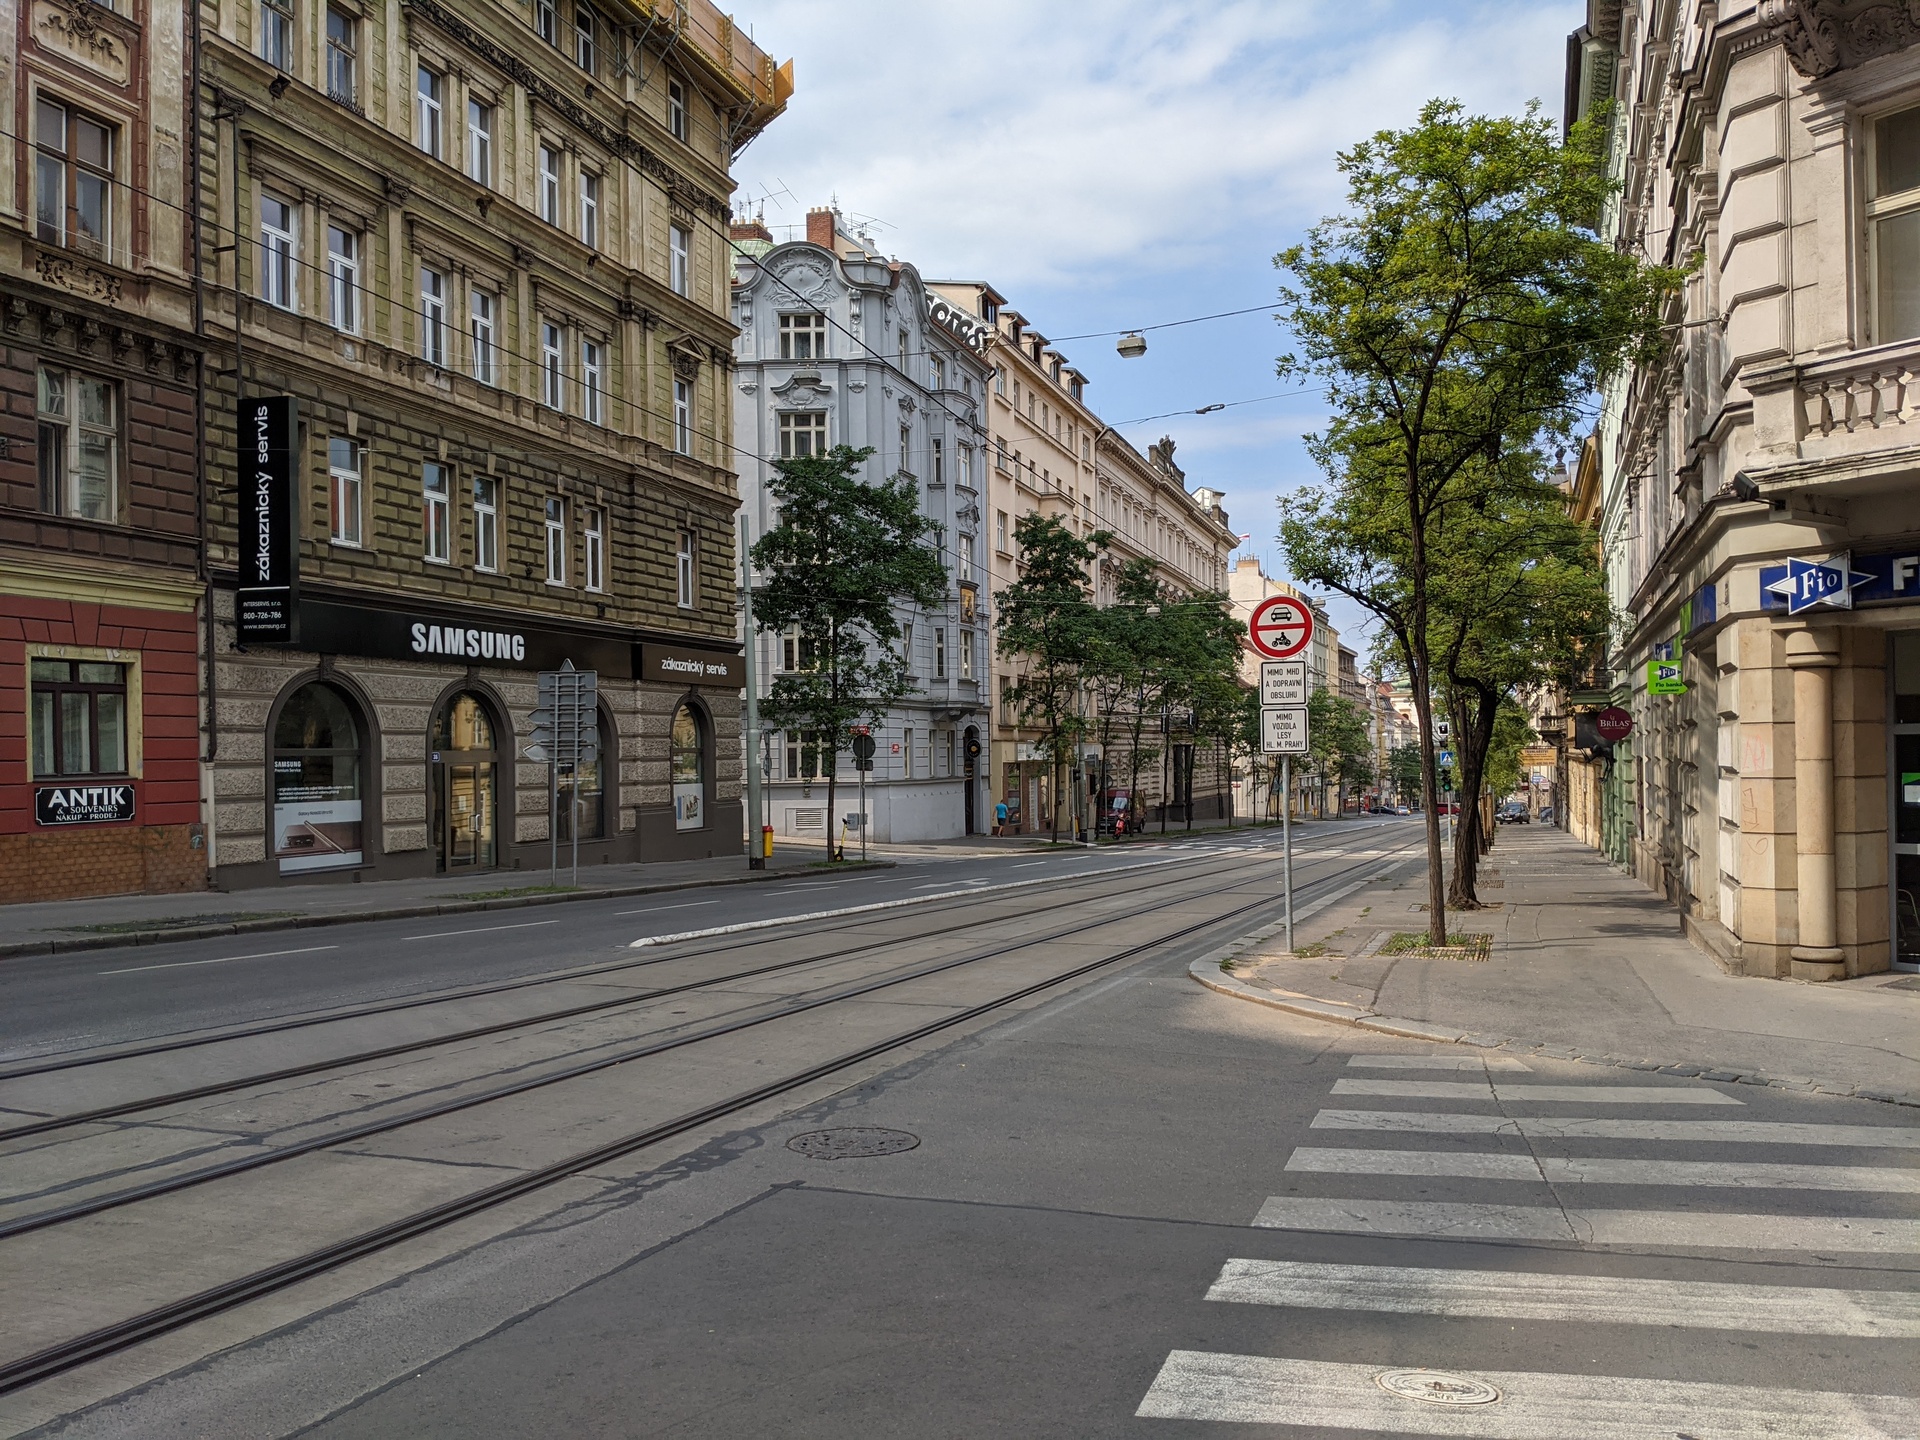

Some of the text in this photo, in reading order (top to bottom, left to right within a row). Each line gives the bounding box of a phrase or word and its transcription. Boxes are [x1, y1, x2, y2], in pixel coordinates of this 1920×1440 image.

[254, 405, 273, 581] zákaznický servis
[1800, 567, 1838, 600] Fio
[243, 611, 282, 619] 800-726-786
[411, 622, 525, 661] SAMSUNG
[661, 656, 728, 677] zákaznický servis
[1287, 668, 1300, 676] MHD
[1662, 668, 1675, 678] Fio
[1265, 677, 1303, 688] A DOPRAVNÍ
[1270, 691, 1298, 700] OBSLUHU
[1275, 713, 1293, 721] MIMO
[1272, 722, 1297, 730] VOZIDLA
[1600, 719, 1631, 727] BRILAS
[1276, 731, 1292, 740] LESY
[1266, 740, 1304, 749] HL. M. PRAHY
[48, 787, 126, 808] ANTIK
[57, 804, 118, 815] & SOUVENIRS
[89, 812, 117, 820] PRODEJ
